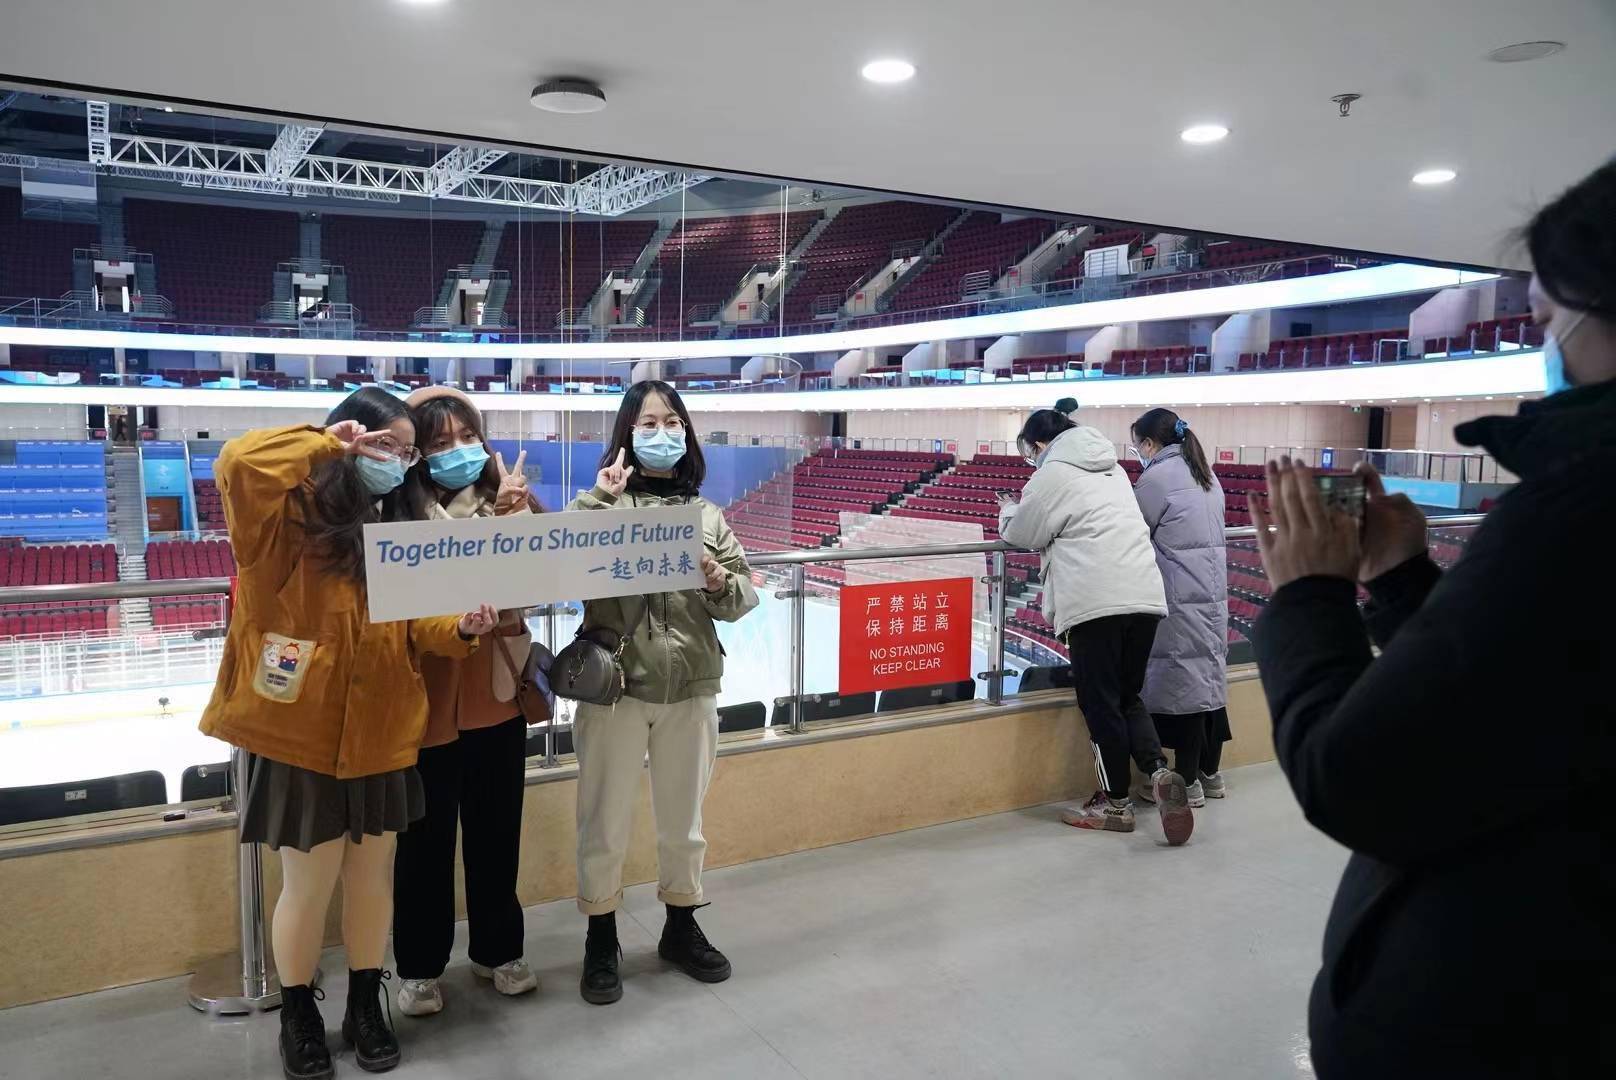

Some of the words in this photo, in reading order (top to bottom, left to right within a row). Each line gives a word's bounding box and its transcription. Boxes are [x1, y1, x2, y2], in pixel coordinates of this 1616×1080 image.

[377, 536, 486, 567] Together
[492, 533, 523, 554] for
[529, 536, 543, 551] a
[548, 524, 624, 550] Shared
[630, 523, 695, 544] Future
[588, 551, 696, 580] 一起向未来
[866, 592, 949, 615] 严禁站立
[866, 613, 949, 637] 保持距离
[869, 648, 886, 660] NO
[889, 642, 945, 658] STANDING
[873, 662, 903, 675] KEEP
[905, 657, 941, 672] CLEAR
